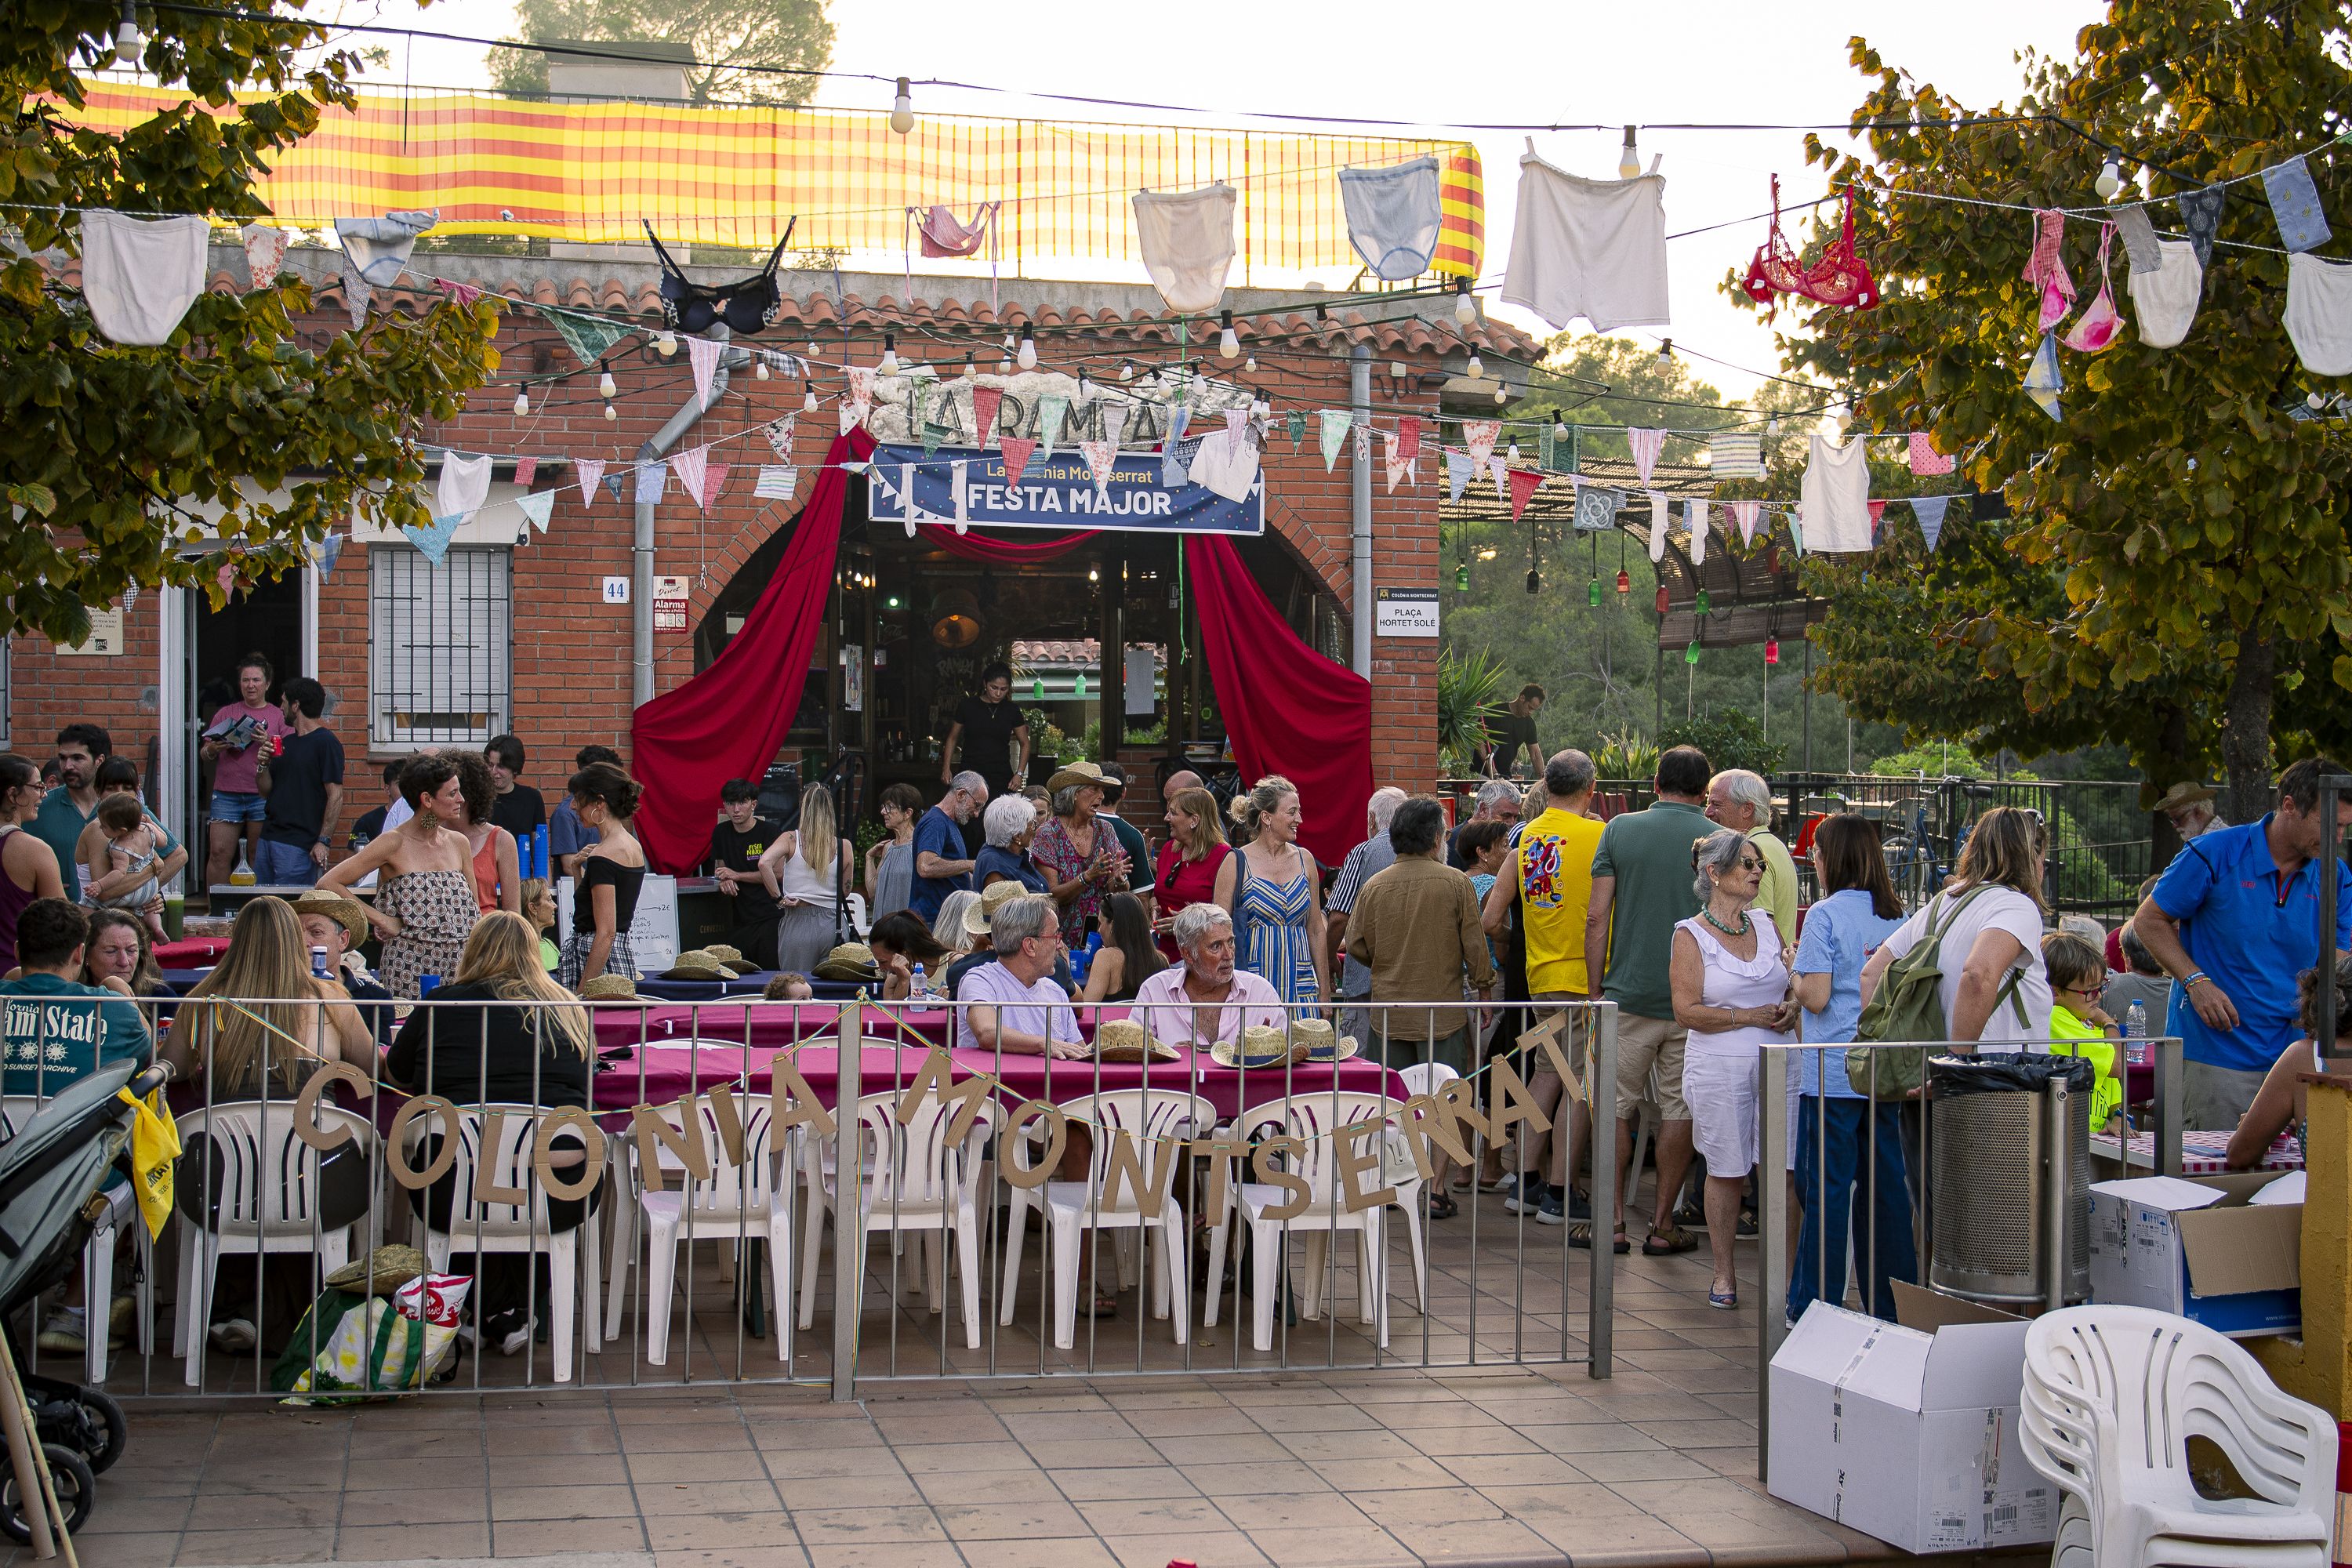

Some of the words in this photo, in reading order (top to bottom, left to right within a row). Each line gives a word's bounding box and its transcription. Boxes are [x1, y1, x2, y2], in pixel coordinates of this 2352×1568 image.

[1069, 466, 1152, 484] Moserrat
[968, 483, 1063, 513] FESTA
[1069, 487, 1173, 516] MAJOR
[608, 583, 625, 597] 44
[655, 600, 686, 609] Alarma
[1395, 608, 1422, 619] PLAÇA
[1414, 618, 1436, 627] SOLÉ
[293, 1051, 837, 1207] COLONIA
[895, 1010, 1587, 1228] MONTSERRAT
